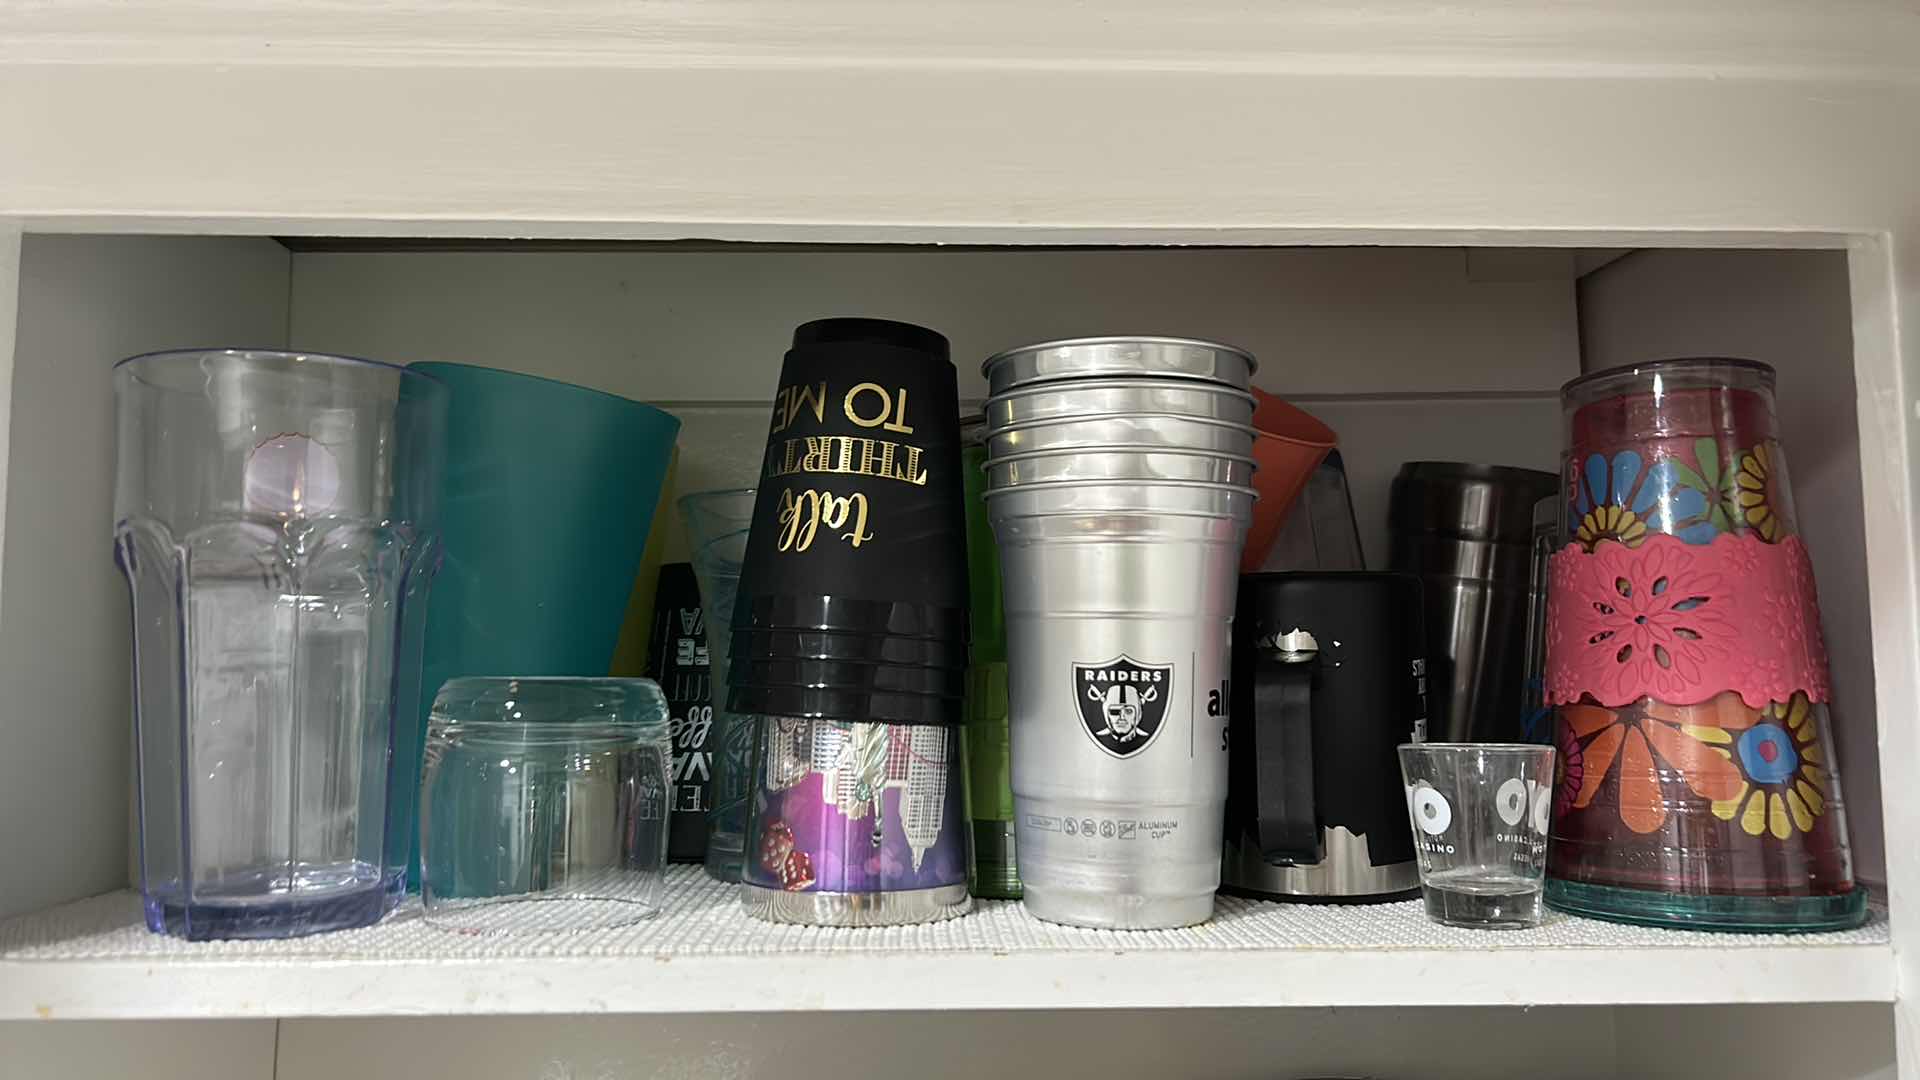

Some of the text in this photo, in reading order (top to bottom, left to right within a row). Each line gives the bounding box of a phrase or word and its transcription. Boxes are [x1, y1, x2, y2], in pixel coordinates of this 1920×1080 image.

[843, 382, 914, 435] TO
[776, 487, 874, 553] talk
[1084, 669, 1162, 682] RAIDERS
